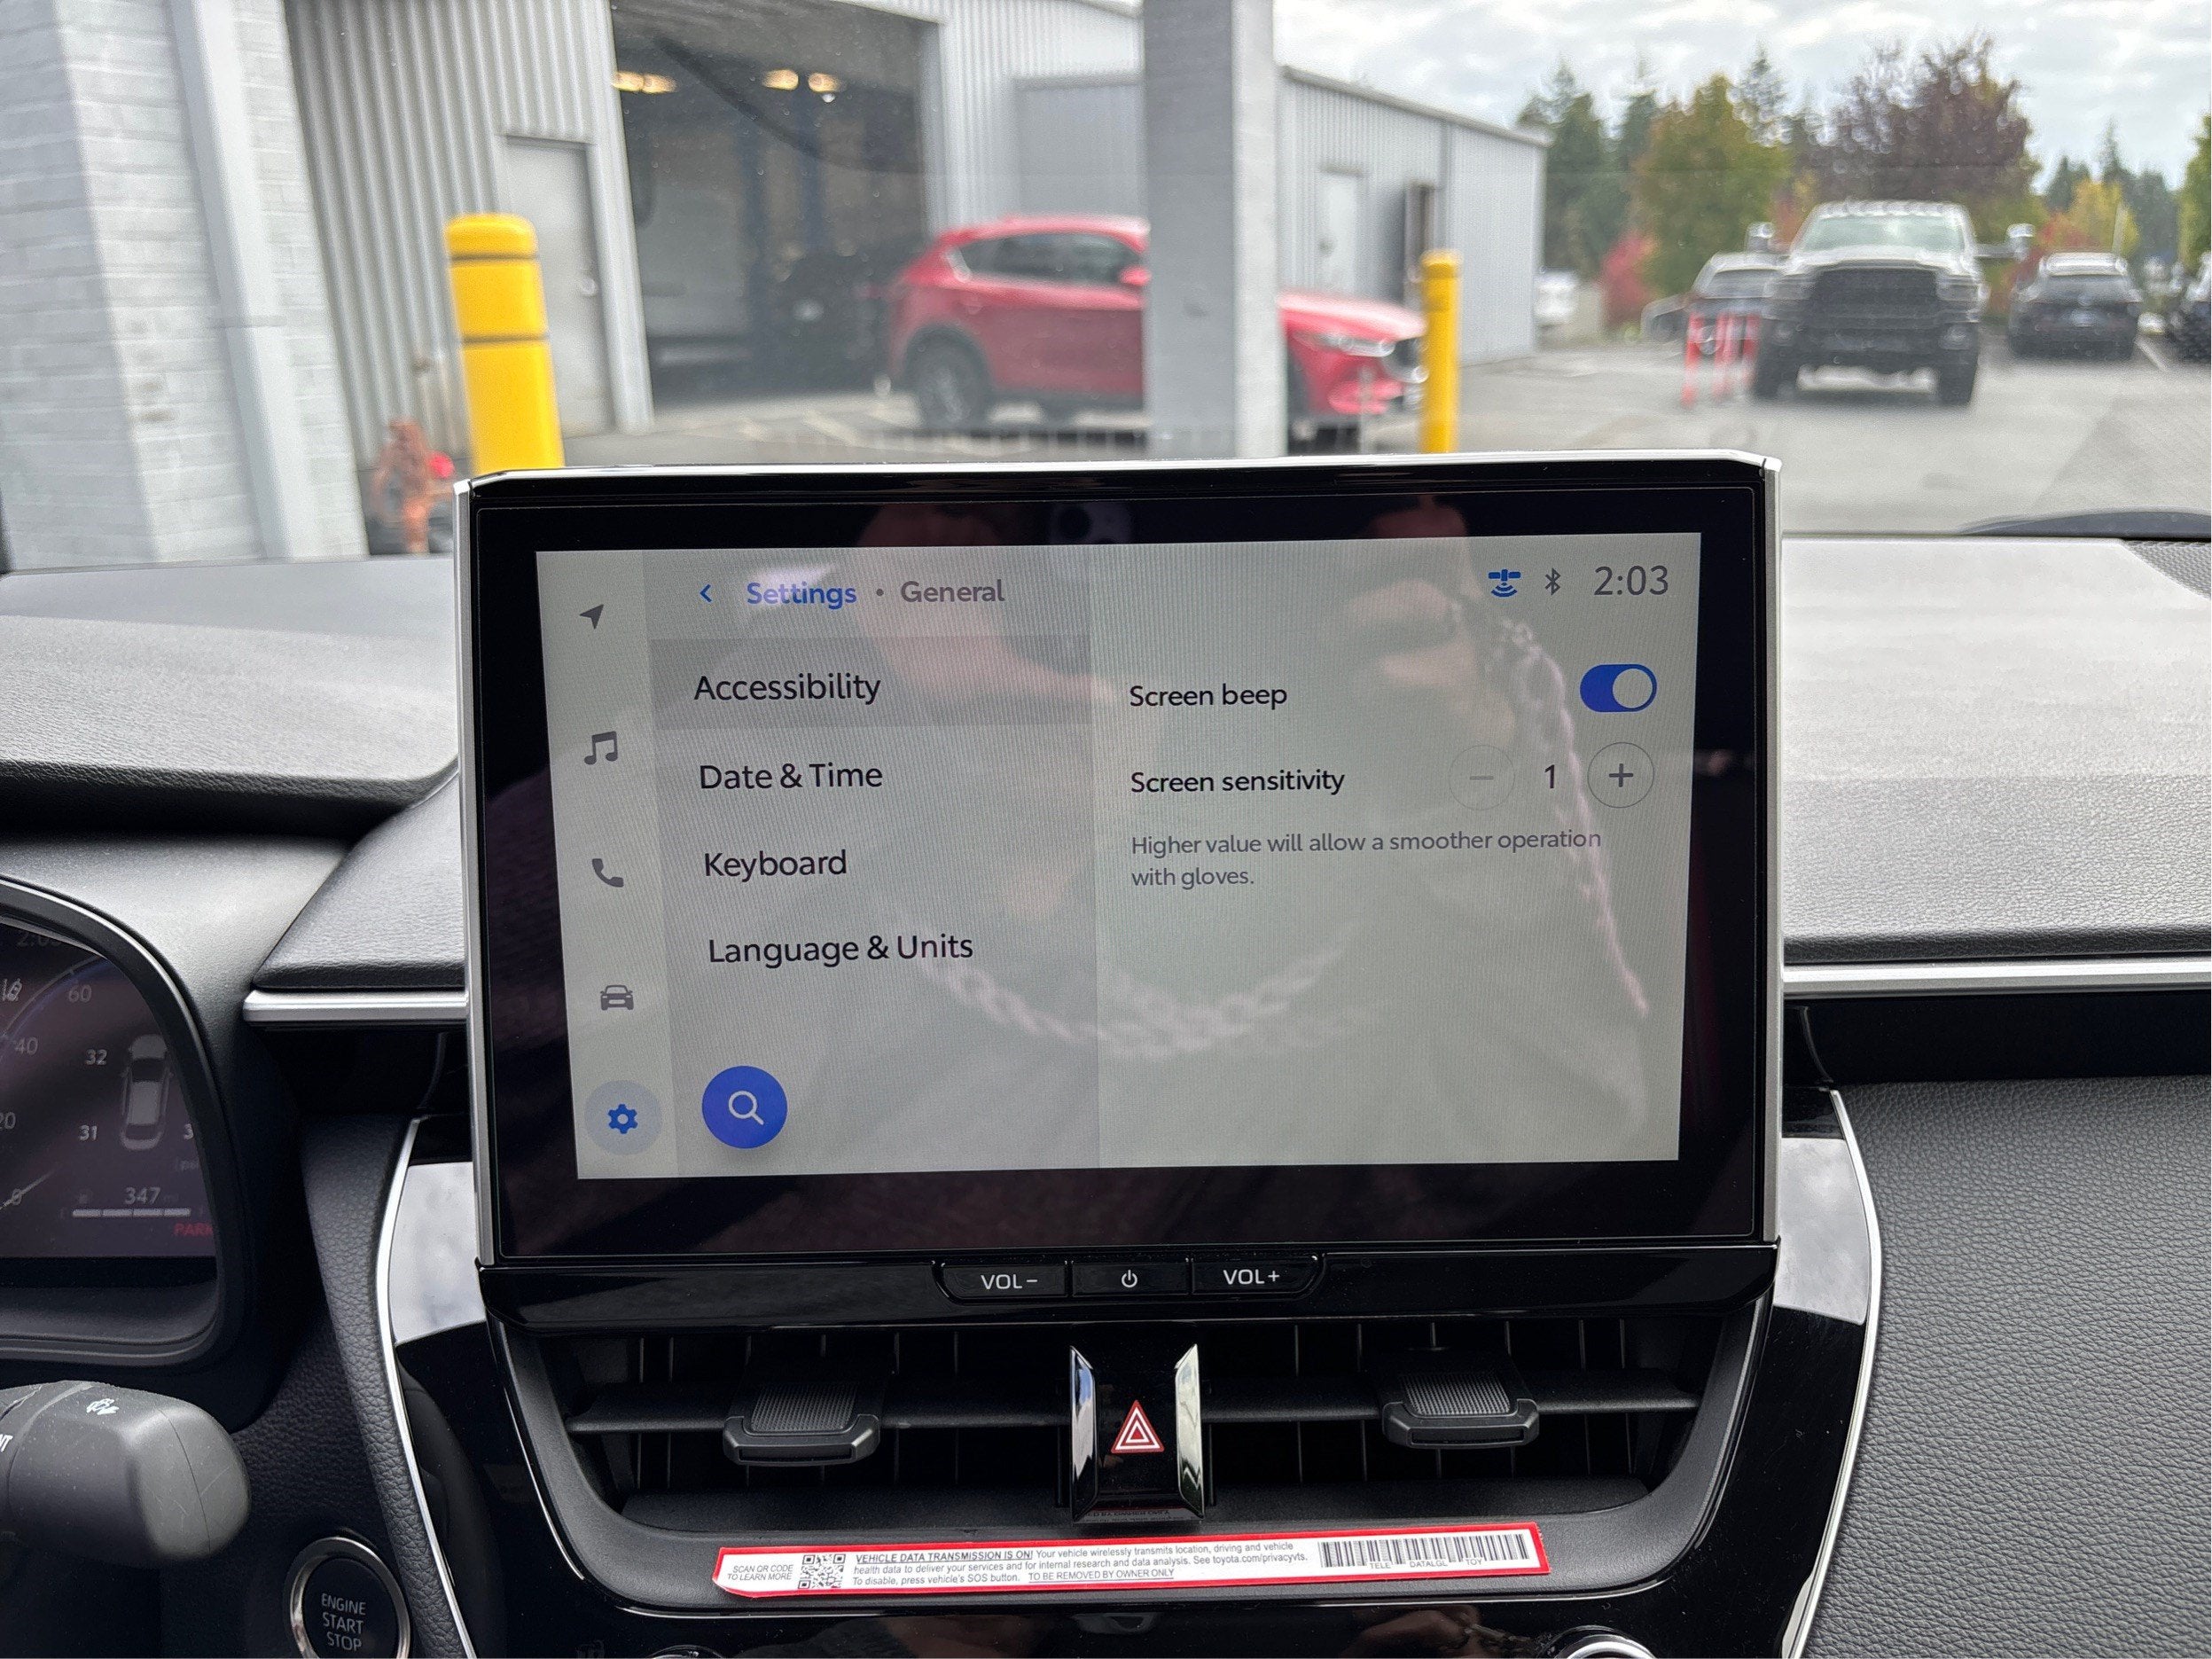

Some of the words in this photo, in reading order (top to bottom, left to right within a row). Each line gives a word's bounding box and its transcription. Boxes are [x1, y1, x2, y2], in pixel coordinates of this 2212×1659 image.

[1594, 566, 1669, 596] 2:03
[746, 582, 856, 609] Settings
[901, 579, 1004, 604] General
[694, 674, 881, 705] Accessibility
[1129, 685, 1214, 707] Screen
[1222, 684, 1287, 709] beep
[700, 764, 772, 788] Date
[779, 763, 802, 788] &
[809, 763, 883, 787] Time
[1130, 771, 1215, 794] Screen
[1222, 769, 1344, 795] sensitivity
[1544, 764, 1556, 789] 1
[1132, 835, 1201, 858] Higher
[1206, 834, 1261, 854] value
[1267, 833, 1303, 852] will
[1309, 833, 1365, 852] allow
[1372, 836, 1384, 851] a
[1389, 831, 1492, 850] smoother
[1497, 829, 1601, 855] operation
[704, 849, 847, 880] Keyboard
[1132, 866, 1176, 887] with
[1181, 865, 1255, 890] gloves.
[709, 937, 859, 968] Language
[868, 936, 889, 959] &
[897, 934, 973, 959] Units
[68, 984, 92, 1003] 60
[14, 1037, 38, 1055] 40
[84, 1049, 107, 1066] 32
[79, 1124, 98, 1141] 31
[124, 1186, 161, 1205] 347
[856, 1553, 897, 1564] VEHICLE
[900, 1552, 926, 1563] DATA
[928, 1551, 1002, 1561] TRANSMISSION
[1004, 1550, 1013, 1560] IS
[1036, 1549, 1055, 1558] Your
[1059, 1548, 1088, 1558] vehicle
[1090, 1547, 1132, 1558] wirelessly
[1135, 1546, 1173, 1555] transmits
[1176, 1545, 1211, 1554] location,
[1214, 1543, 1242, 1553] driving
[1245, 1542, 1261, 1552] and
[1263, 1541, 1294, 1551] vehicle
[1466, 1557, 1482, 1566] TOY
[732, 1564, 754, 1573] SCAN
[770, 1564, 793, 1573] CODE
[854, 1565, 880, 1574] health
[882, 1564, 902, 1574] data
[904, 1564, 912, 1573] to
[916, 1563, 944, 1573] deliver
[946, 1563, 965, 1574] your
[968, 1562, 1004, 1571] services
[1006, 1561, 1022, 1570] and
[1025, 1561, 1036, 1569] for
[1039, 1560, 1070, 1569] internal
[1073, 1559, 1110, 1569] research
[1113, 1558, 1129, 1567] and
[1132, 1558, 1151, 1567] data
[1153, 1556, 1190, 1567] analysis.
[1193, 1555, 1210, 1564] See
[1029, 1572, 1040, 1581] TO
[1043, 1571, 1054, 1580] BE
[1056, 1570, 1100, 1580] REMOVED
[1103, 1569, 1114, 1579] BY
[1116, 1569, 1149, 1578] OWNER
[1152, 1568, 1175, 1577] ONLY
[768, 1572, 792, 1581] MORE
[853, 1577, 863, 1585] To
[865, 1576, 898, 1585] disable,
[901, 1576, 925, 1585] press
[928, 1574, 965, 1584] vehicle's
[967, 1573, 988, 1582] SOS
[990, 1572, 1020, 1582] button.
[321, 1592, 366, 1616] ENGINE
[322, 1611, 363, 1634] START
[326, 1631, 362, 1652] STOP
